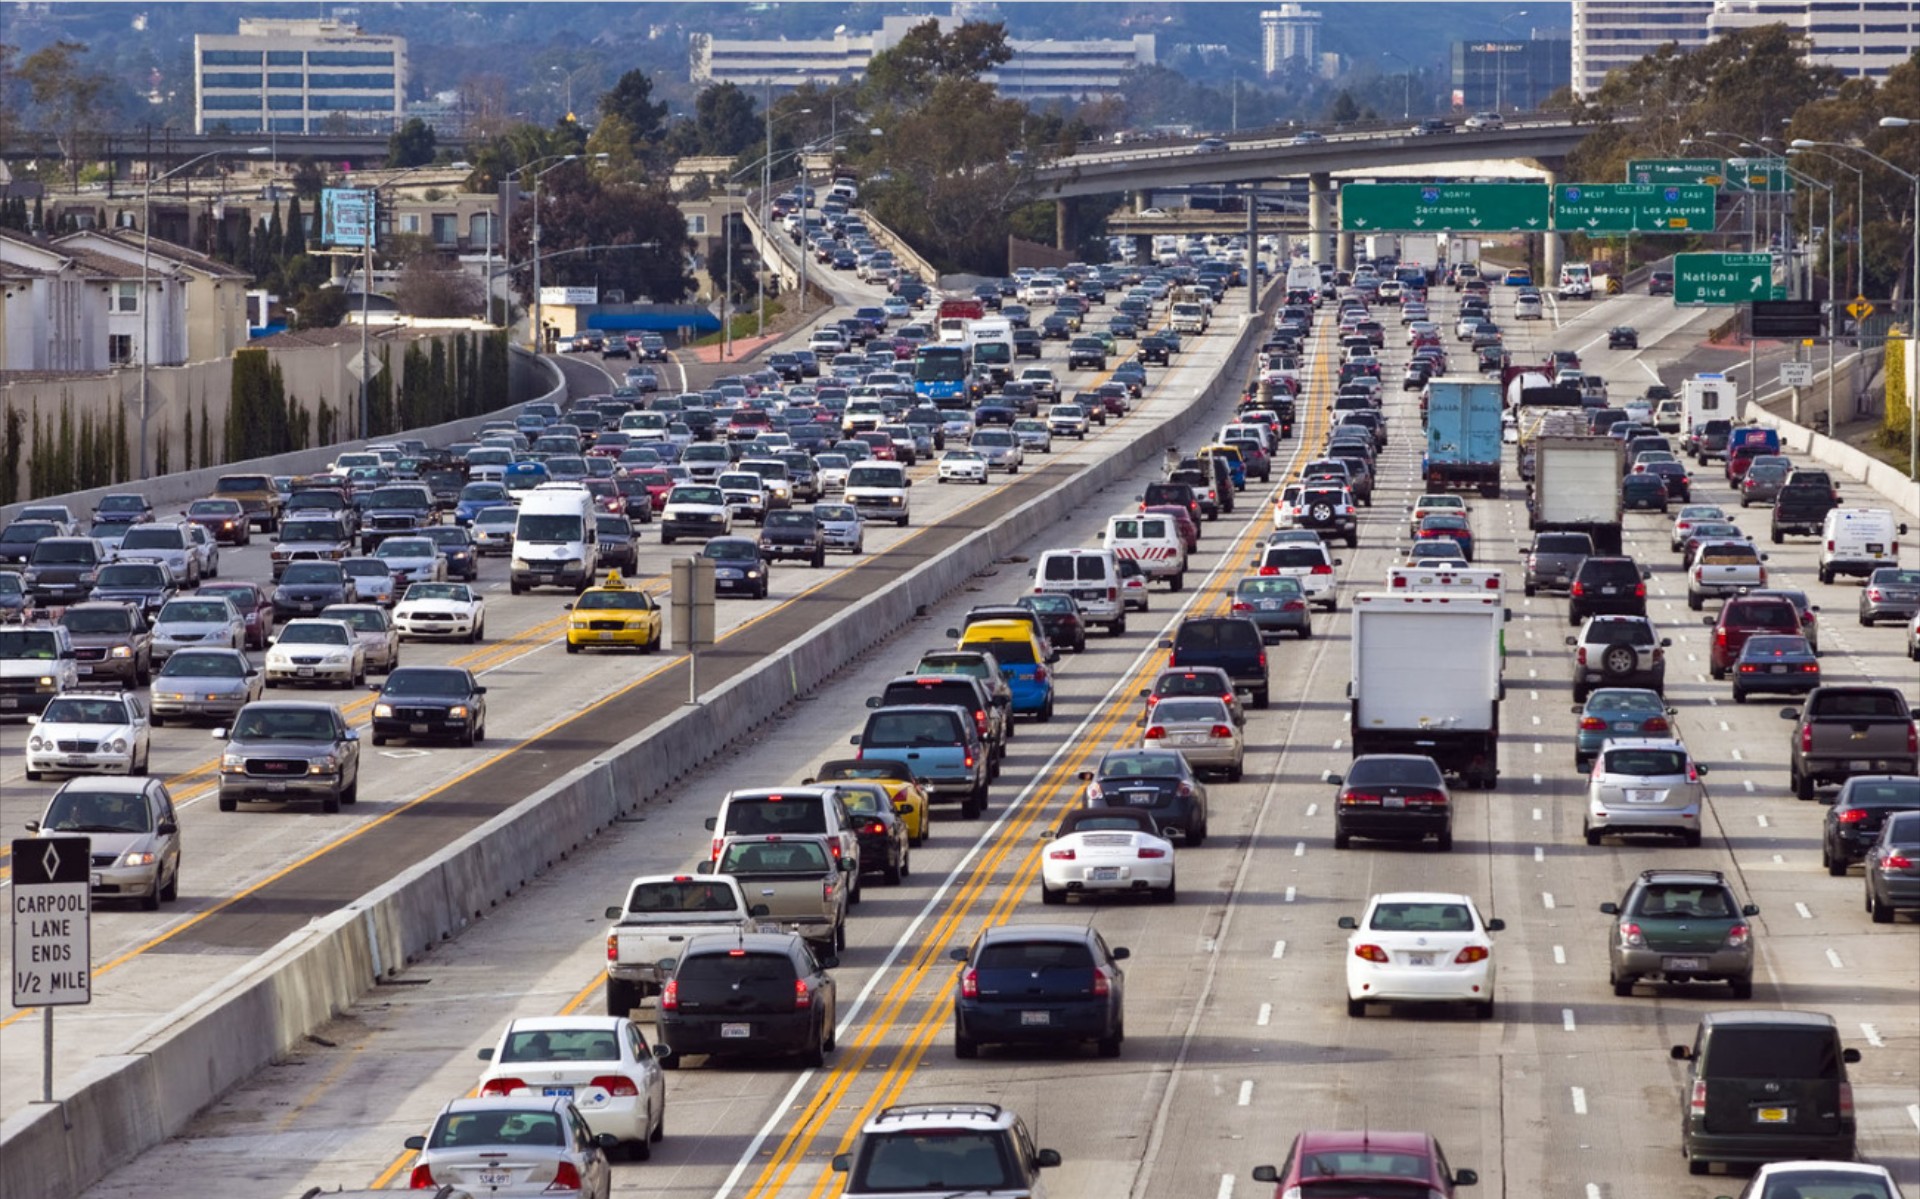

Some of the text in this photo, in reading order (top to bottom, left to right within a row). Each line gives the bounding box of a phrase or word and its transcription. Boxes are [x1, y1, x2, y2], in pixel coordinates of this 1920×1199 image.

[1416, 206, 1477, 214] Sacramento
[1559, 206, 1631, 215] Santa Monica
[1643, 206, 1706, 216] Los Angeles
[1683, 272, 1740, 281] National
[1697, 287, 1727, 297] Blvd
[17, 894, 86, 913] CARPOOL
[31, 919, 71, 938] LANE
[32, 944, 72, 963] ENDS
[18, 971, 86, 993] 1/2 MILE
